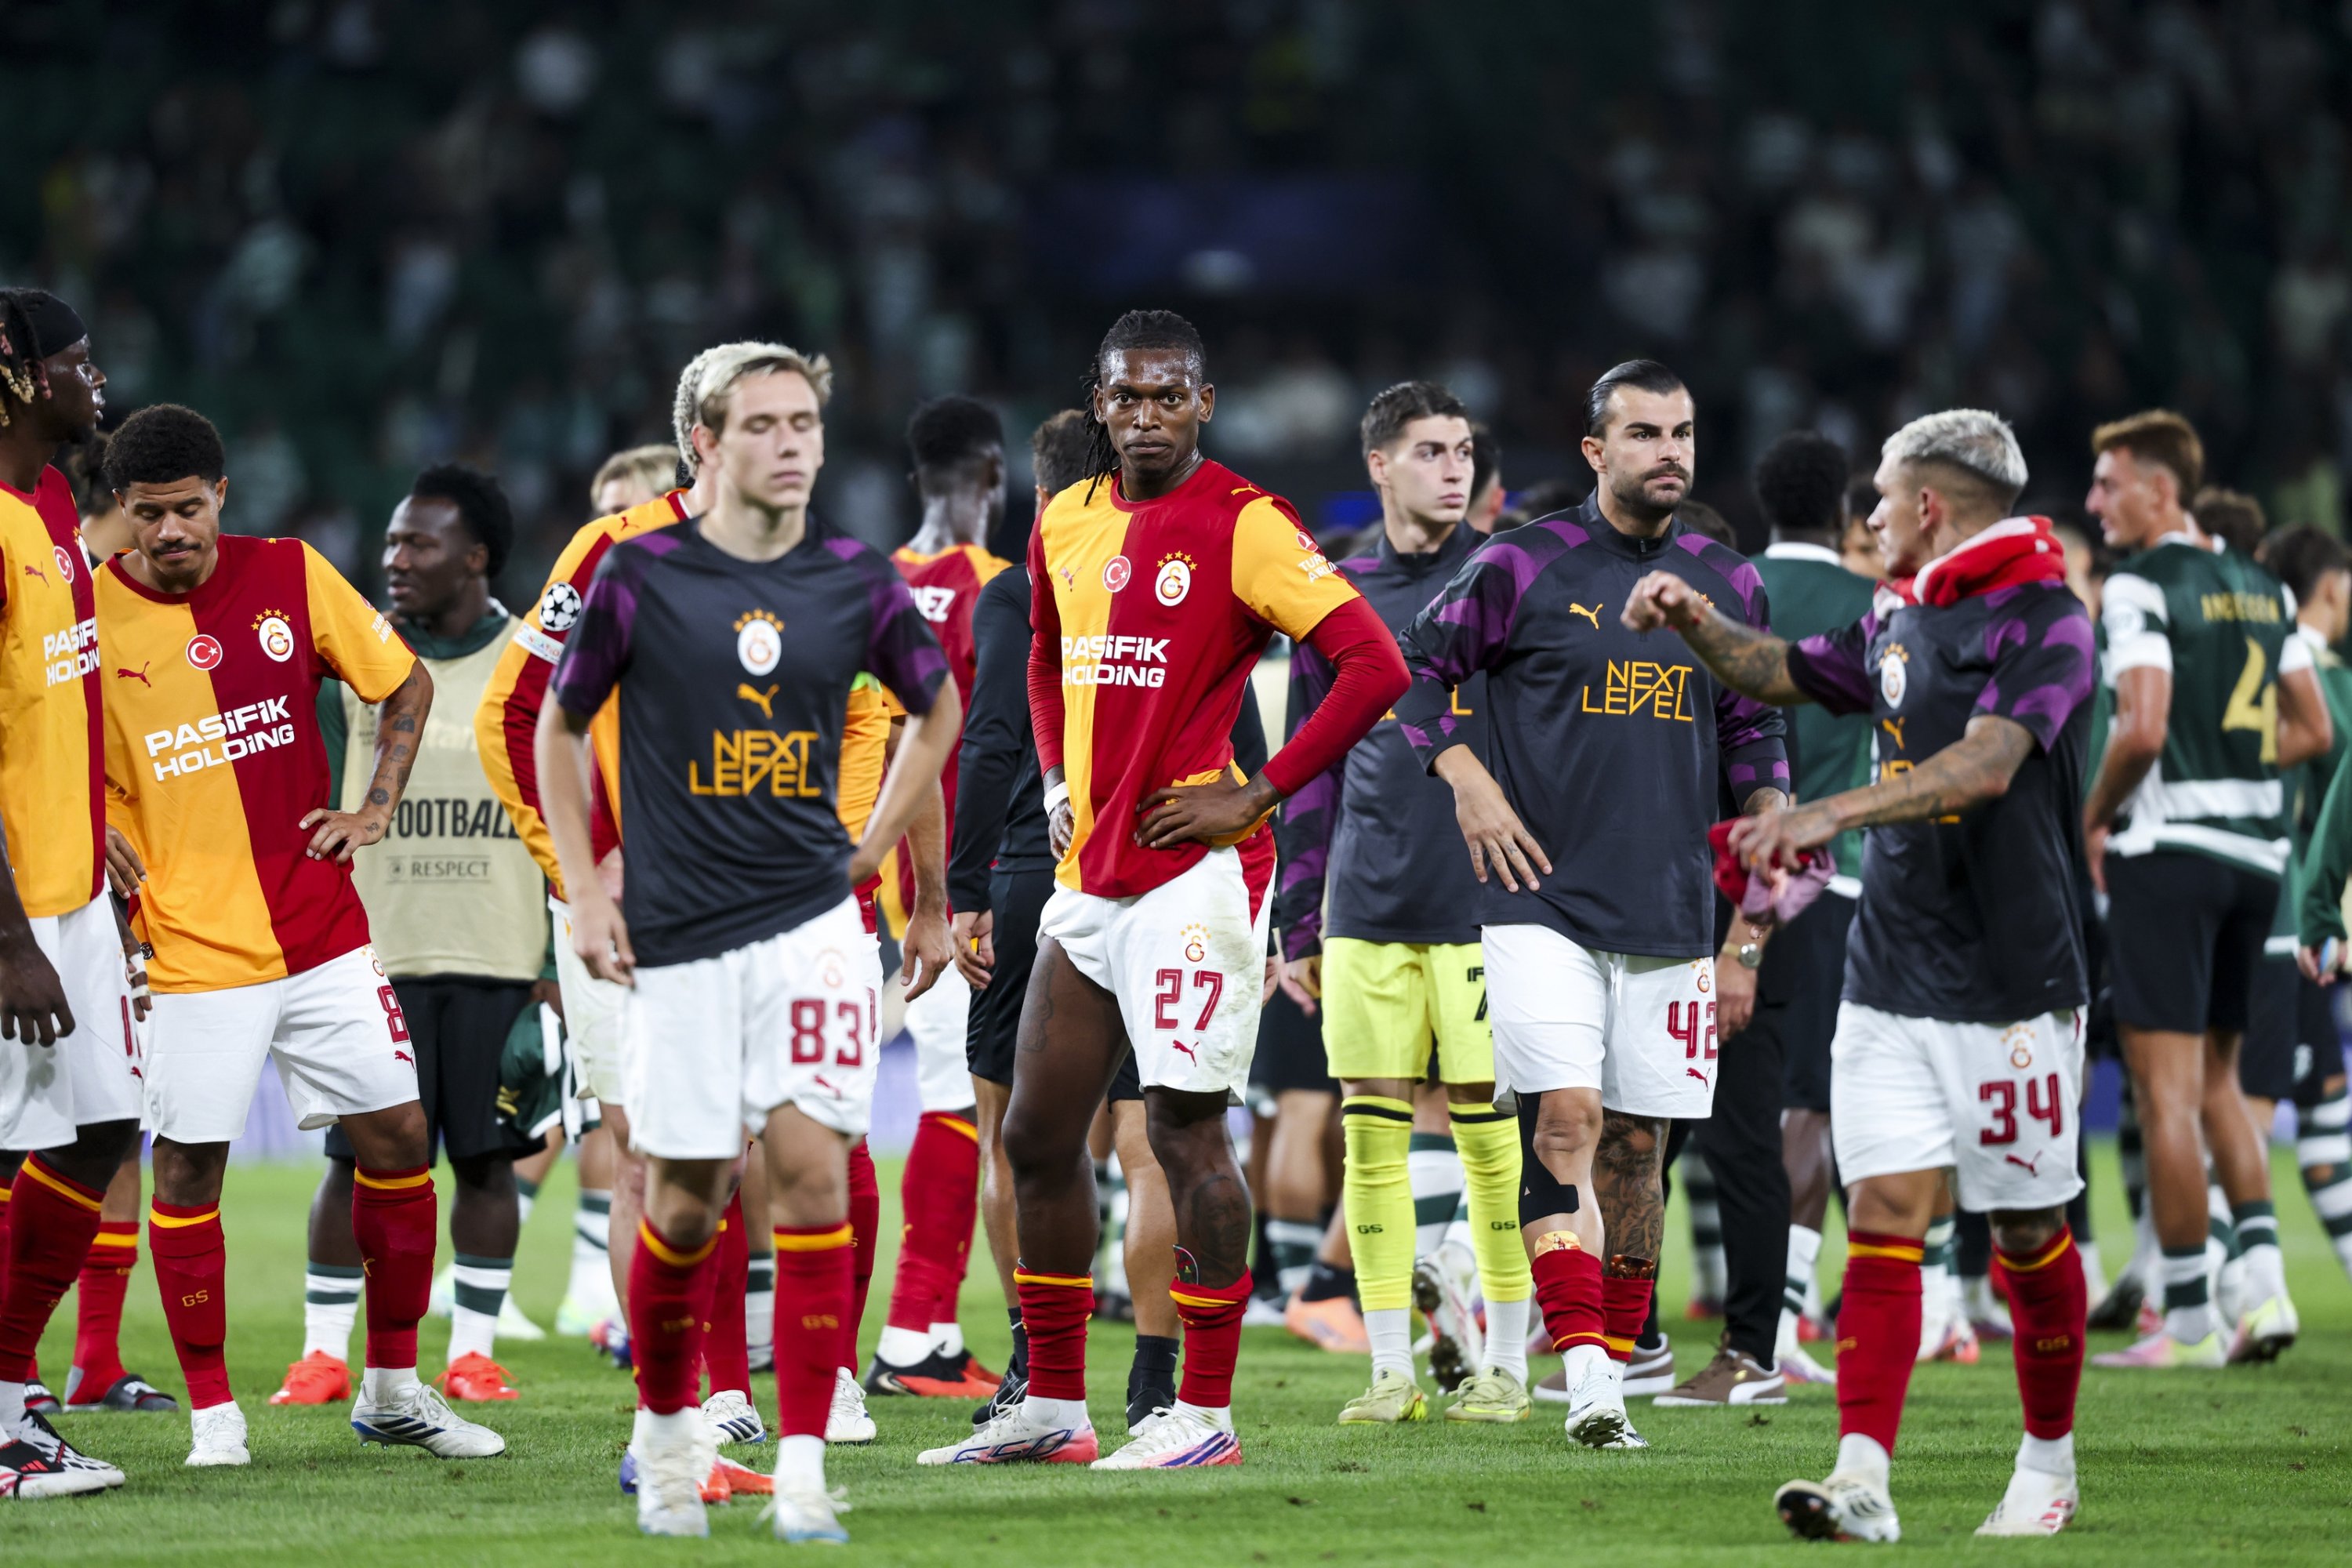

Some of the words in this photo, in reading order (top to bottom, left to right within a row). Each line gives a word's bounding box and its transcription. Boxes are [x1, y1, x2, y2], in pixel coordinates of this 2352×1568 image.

[43, 616, 98, 662] PASIFI
[46, 646, 100, 688] HOLDIN
[1606, 659, 1693, 693] NEXT
[1582, 685, 1693, 722] LEVEL
[2222, 636, 2278, 765] 4
[713, 728, 819, 764] NEXT
[688, 760, 822, 797] LEVEL
[412, 860, 490, 880] RESPECT
[376, 985, 411, 1044] 8
[1155, 967, 1224, 1033] 27
[121, 994, 142, 1058] 1
[791, 998, 862, 1067] 83
[1667, 1000, 1718, 1061] 42
[1979, 1072, 2063, 1147] 34
[1357, 1223, 1384, 1235] GS
[1490, 1220, 1516, 1231] GS
[182, 1289, 209, 1308] GS
